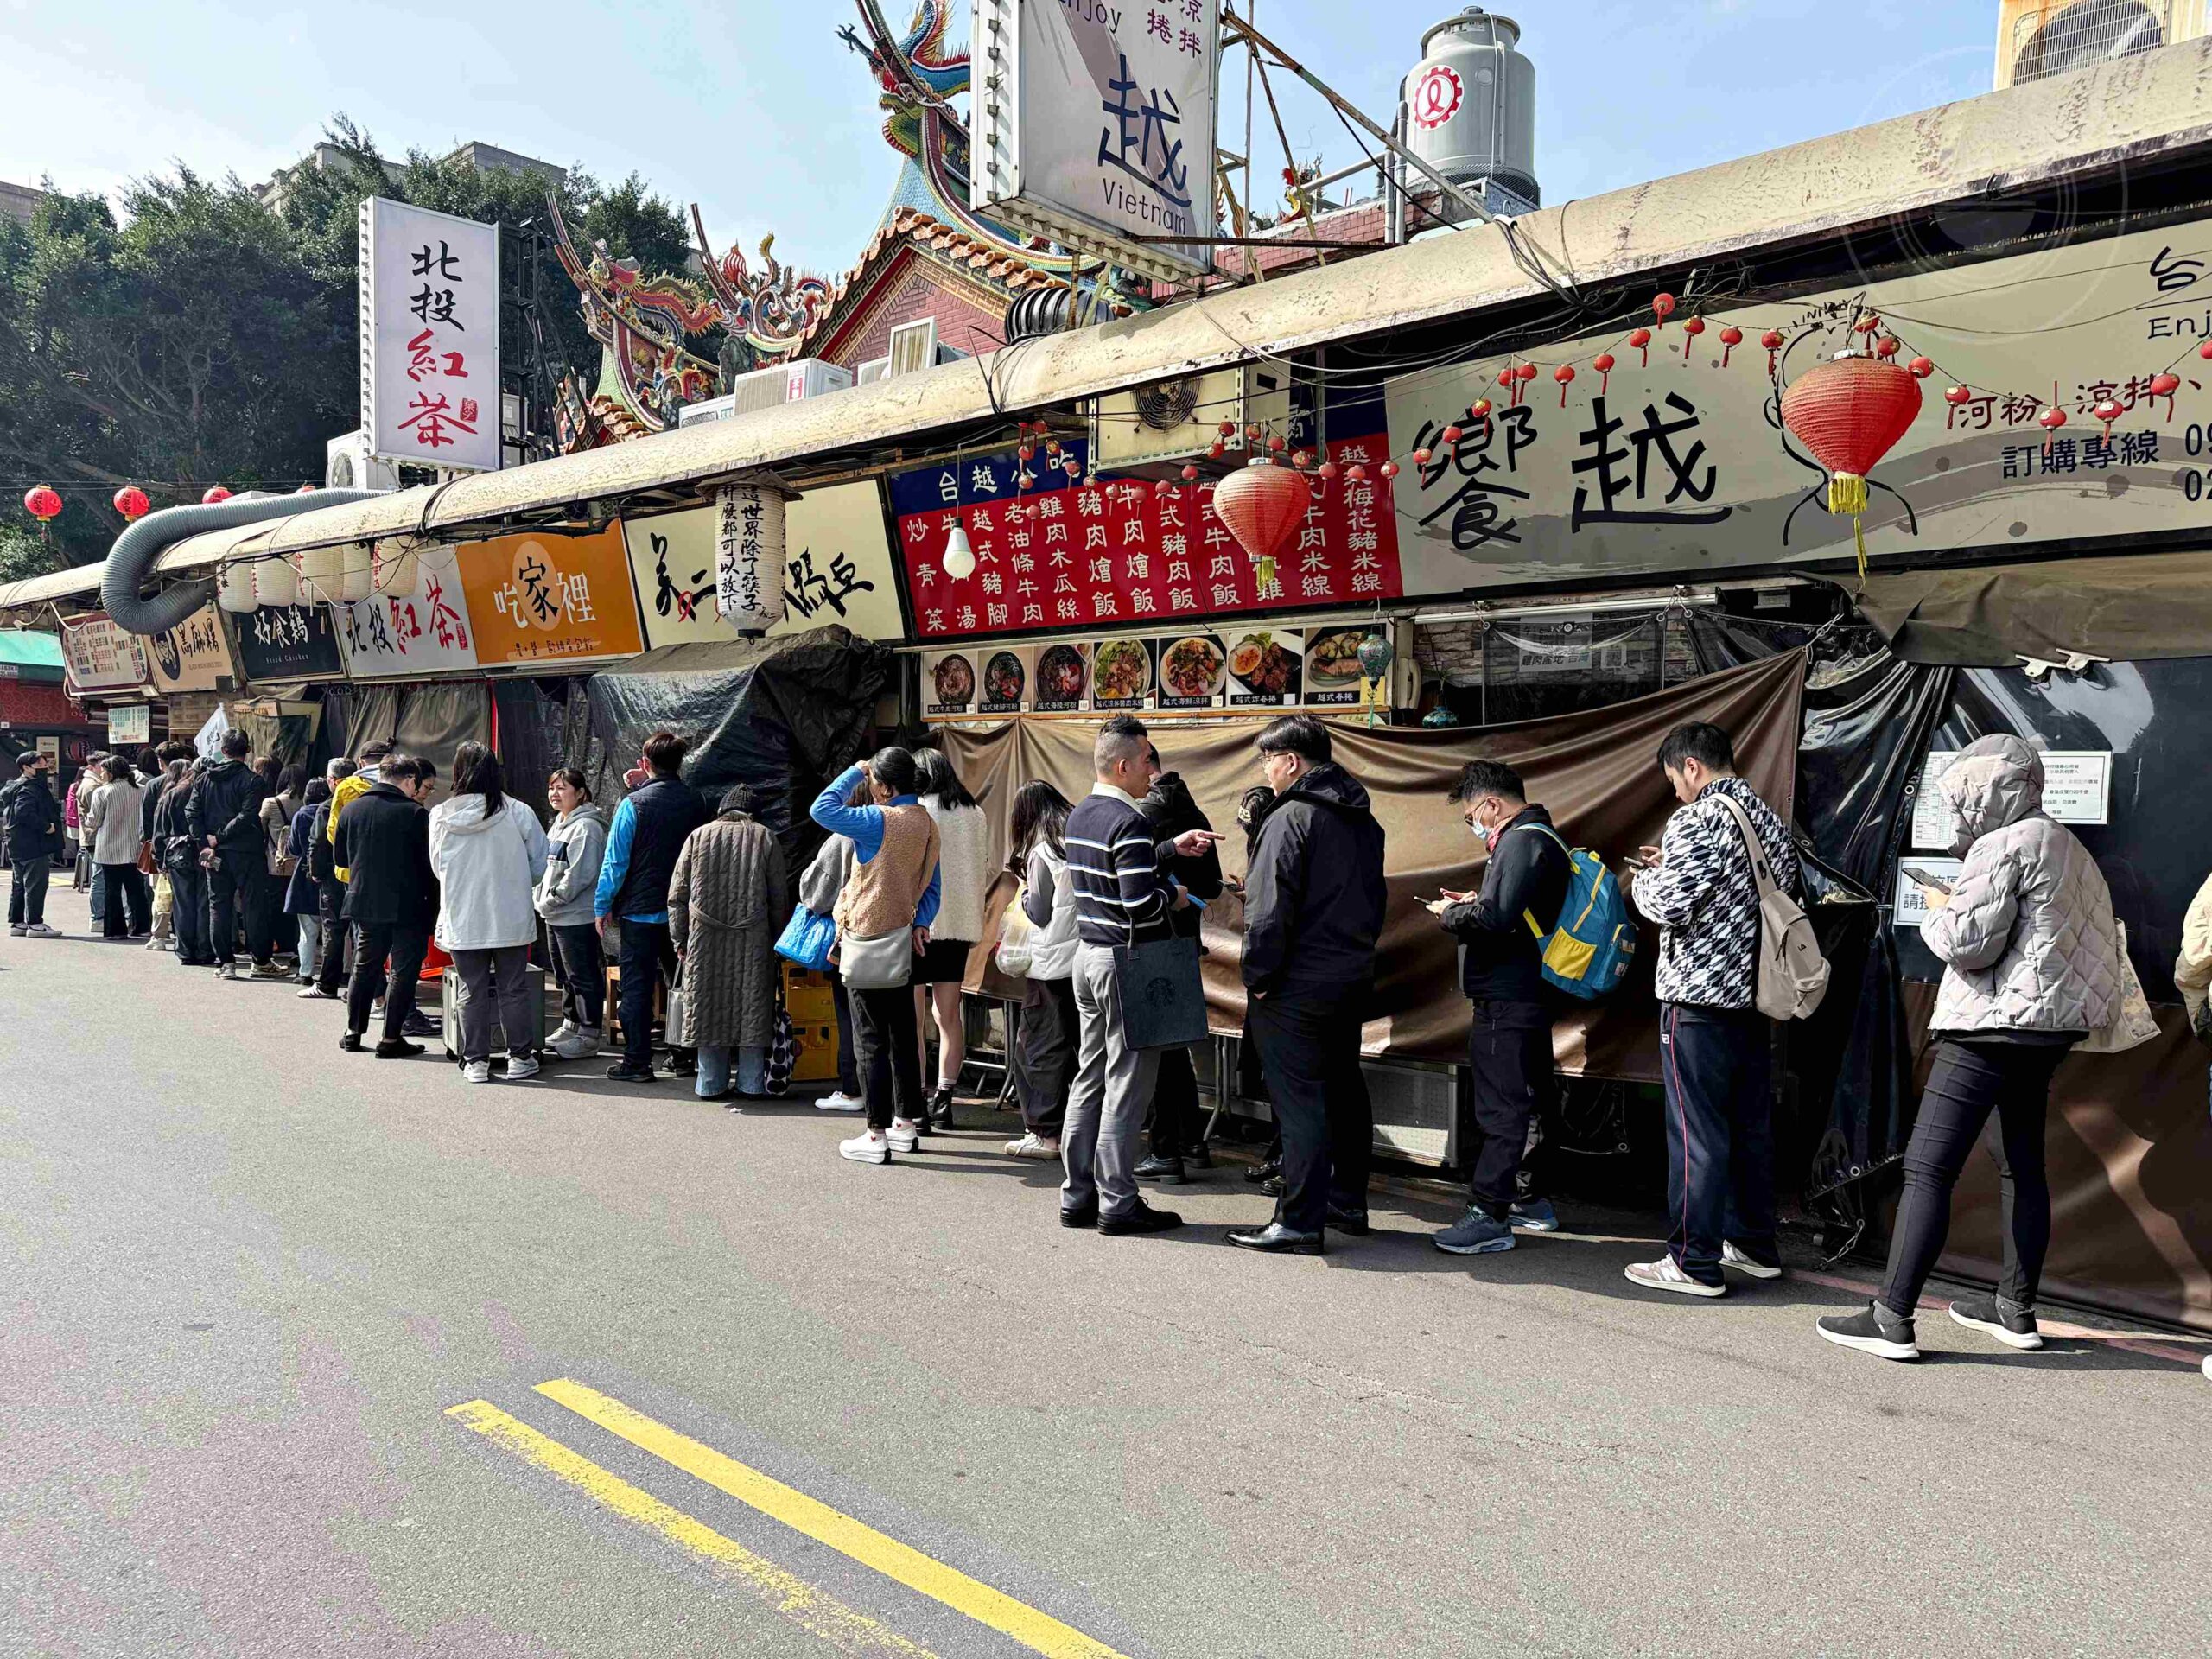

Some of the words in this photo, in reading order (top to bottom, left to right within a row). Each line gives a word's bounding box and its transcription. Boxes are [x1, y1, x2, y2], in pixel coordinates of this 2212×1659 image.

[1060, 0, 1122, 34] njoy
[1097, 53, 1192, 208] 越
[1103, 178, 1186, 236] Vietnam
[398, 240, 478, 448] 北投紅茶
[2001, 429, 2160, 480] 訂購專線
[493, 556, 596, 629] 吃家裡
[941, 514, 977, 629] 牛湯
[972, 508, 1008, 626] 越式豬腳
[1004, 502, 1044, 624] 老油條牛肉
[1039, 495, 1080, 620] 雞肉木瓜絲
[1078, 490, 1119, 617] 豬肉燴飯
[1116, 483, 1157, 614] 牛肉燴飯
[346, 574, 461, 657] 北投紅茶
